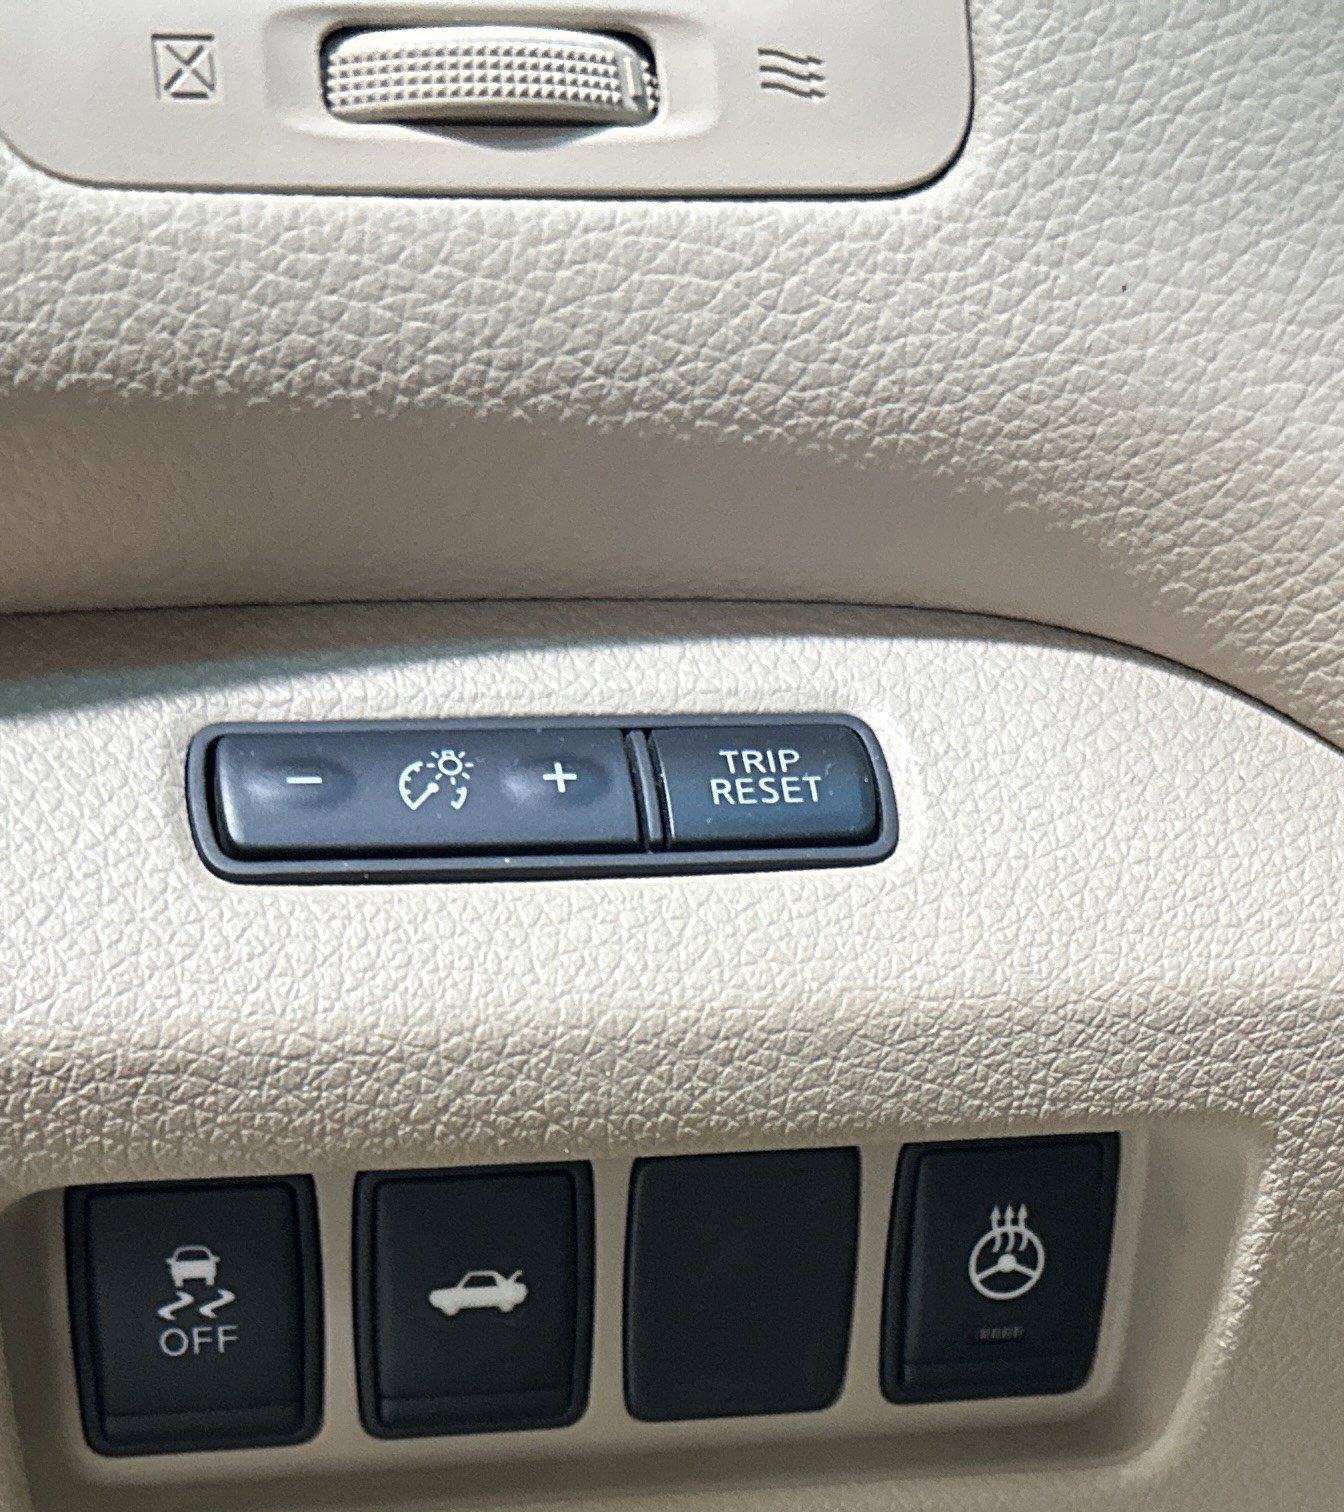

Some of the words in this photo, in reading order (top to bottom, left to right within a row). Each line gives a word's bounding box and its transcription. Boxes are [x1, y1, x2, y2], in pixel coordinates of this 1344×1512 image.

[719, 748, 802, 774] TRIP
[711, 775, 822, 806] RESET
[158, 1323, 239, 1358] OFF
